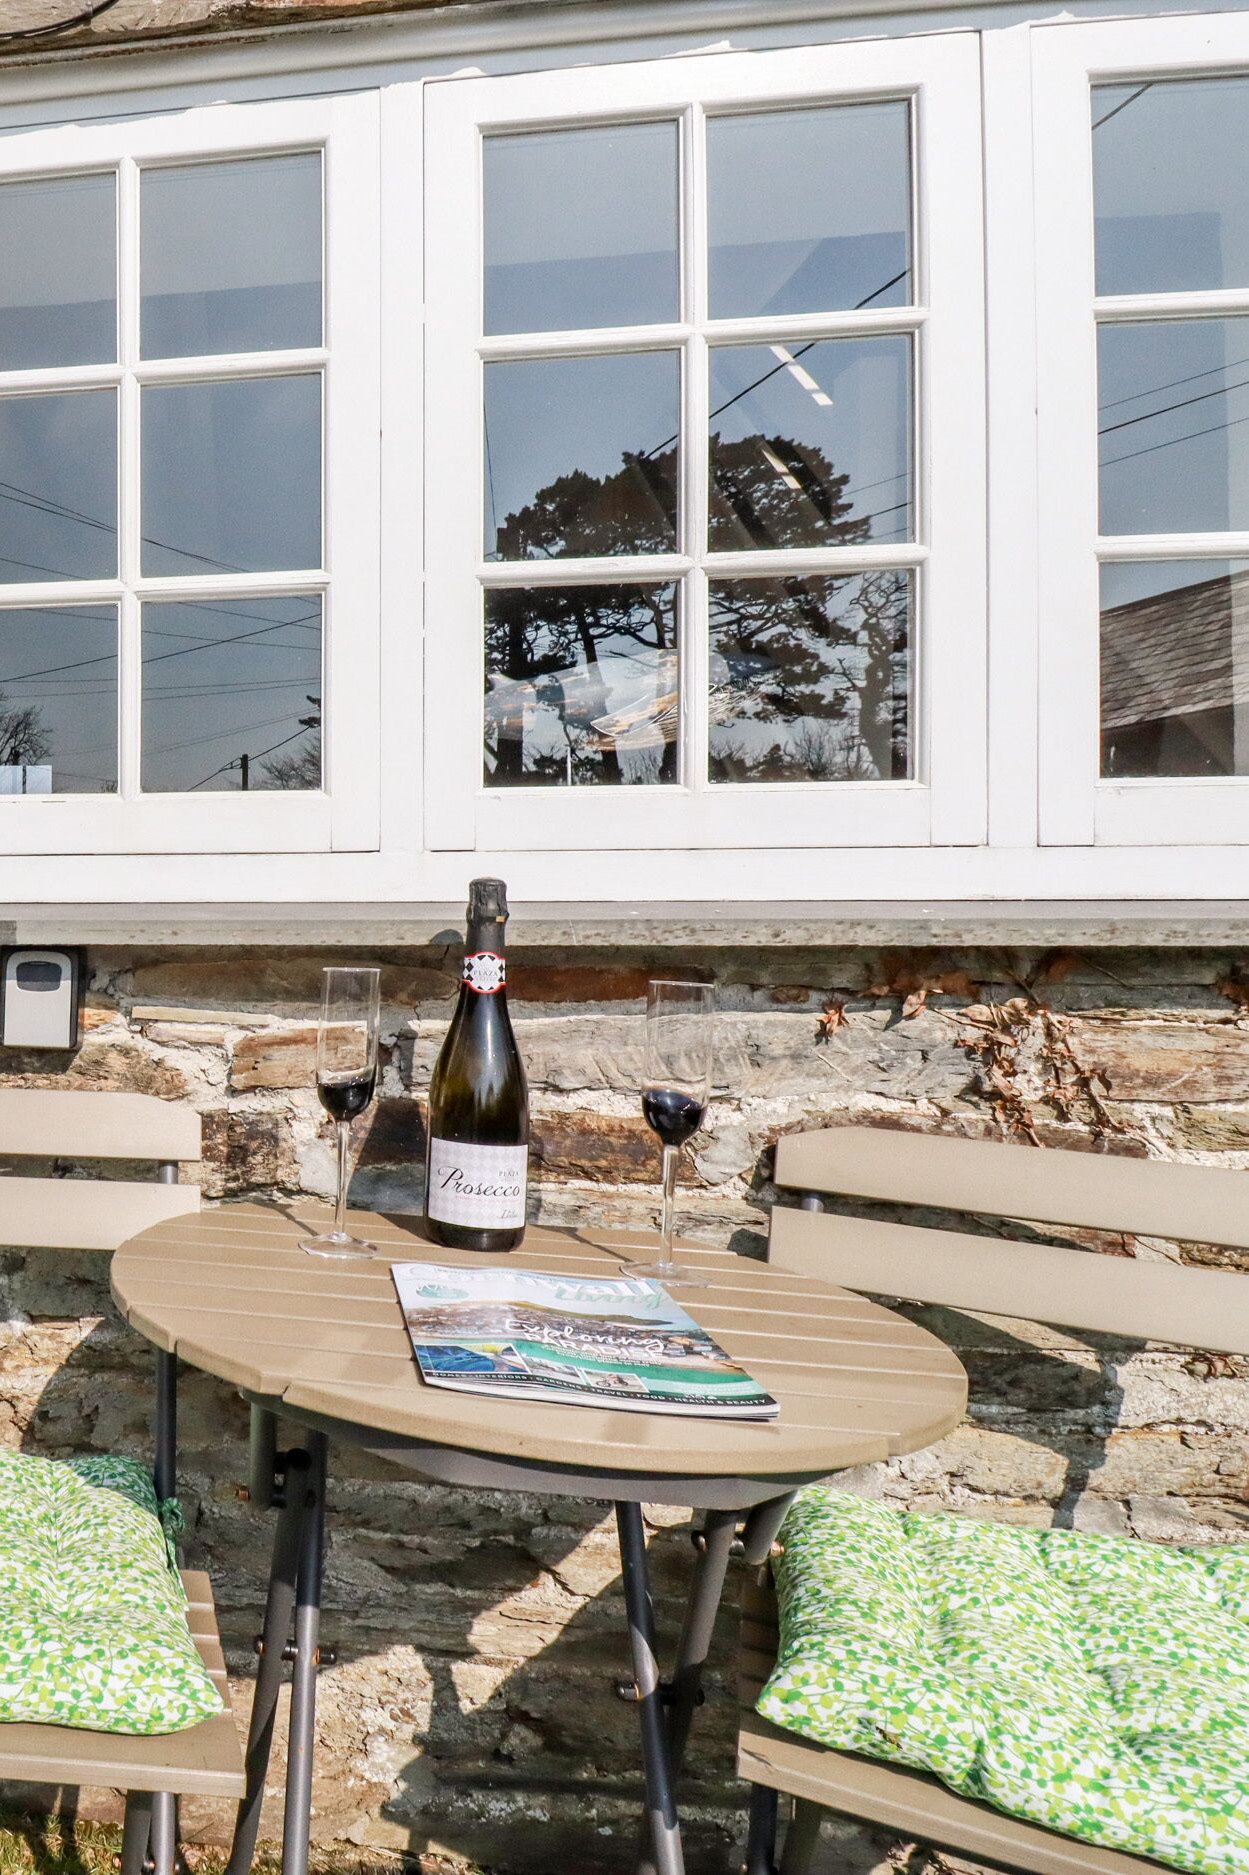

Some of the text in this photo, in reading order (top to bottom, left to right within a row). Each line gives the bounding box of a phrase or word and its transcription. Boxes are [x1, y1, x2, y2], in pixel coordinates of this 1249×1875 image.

[437, 1165, 520, 1197] Prosecco
[505, 1318, 666, 1353] Exploring
[432, 1371, 467, 1379] HOMES
[475, 1373, 527, 1381] INTERIORS
[536, 1376, 582, 1391] GARDENS
[591, 1388, 627, 1398] TRAVEL
[636, 1393, 666, 1401] FOOD
[674, 1397, 714, 1405] HEALTH
